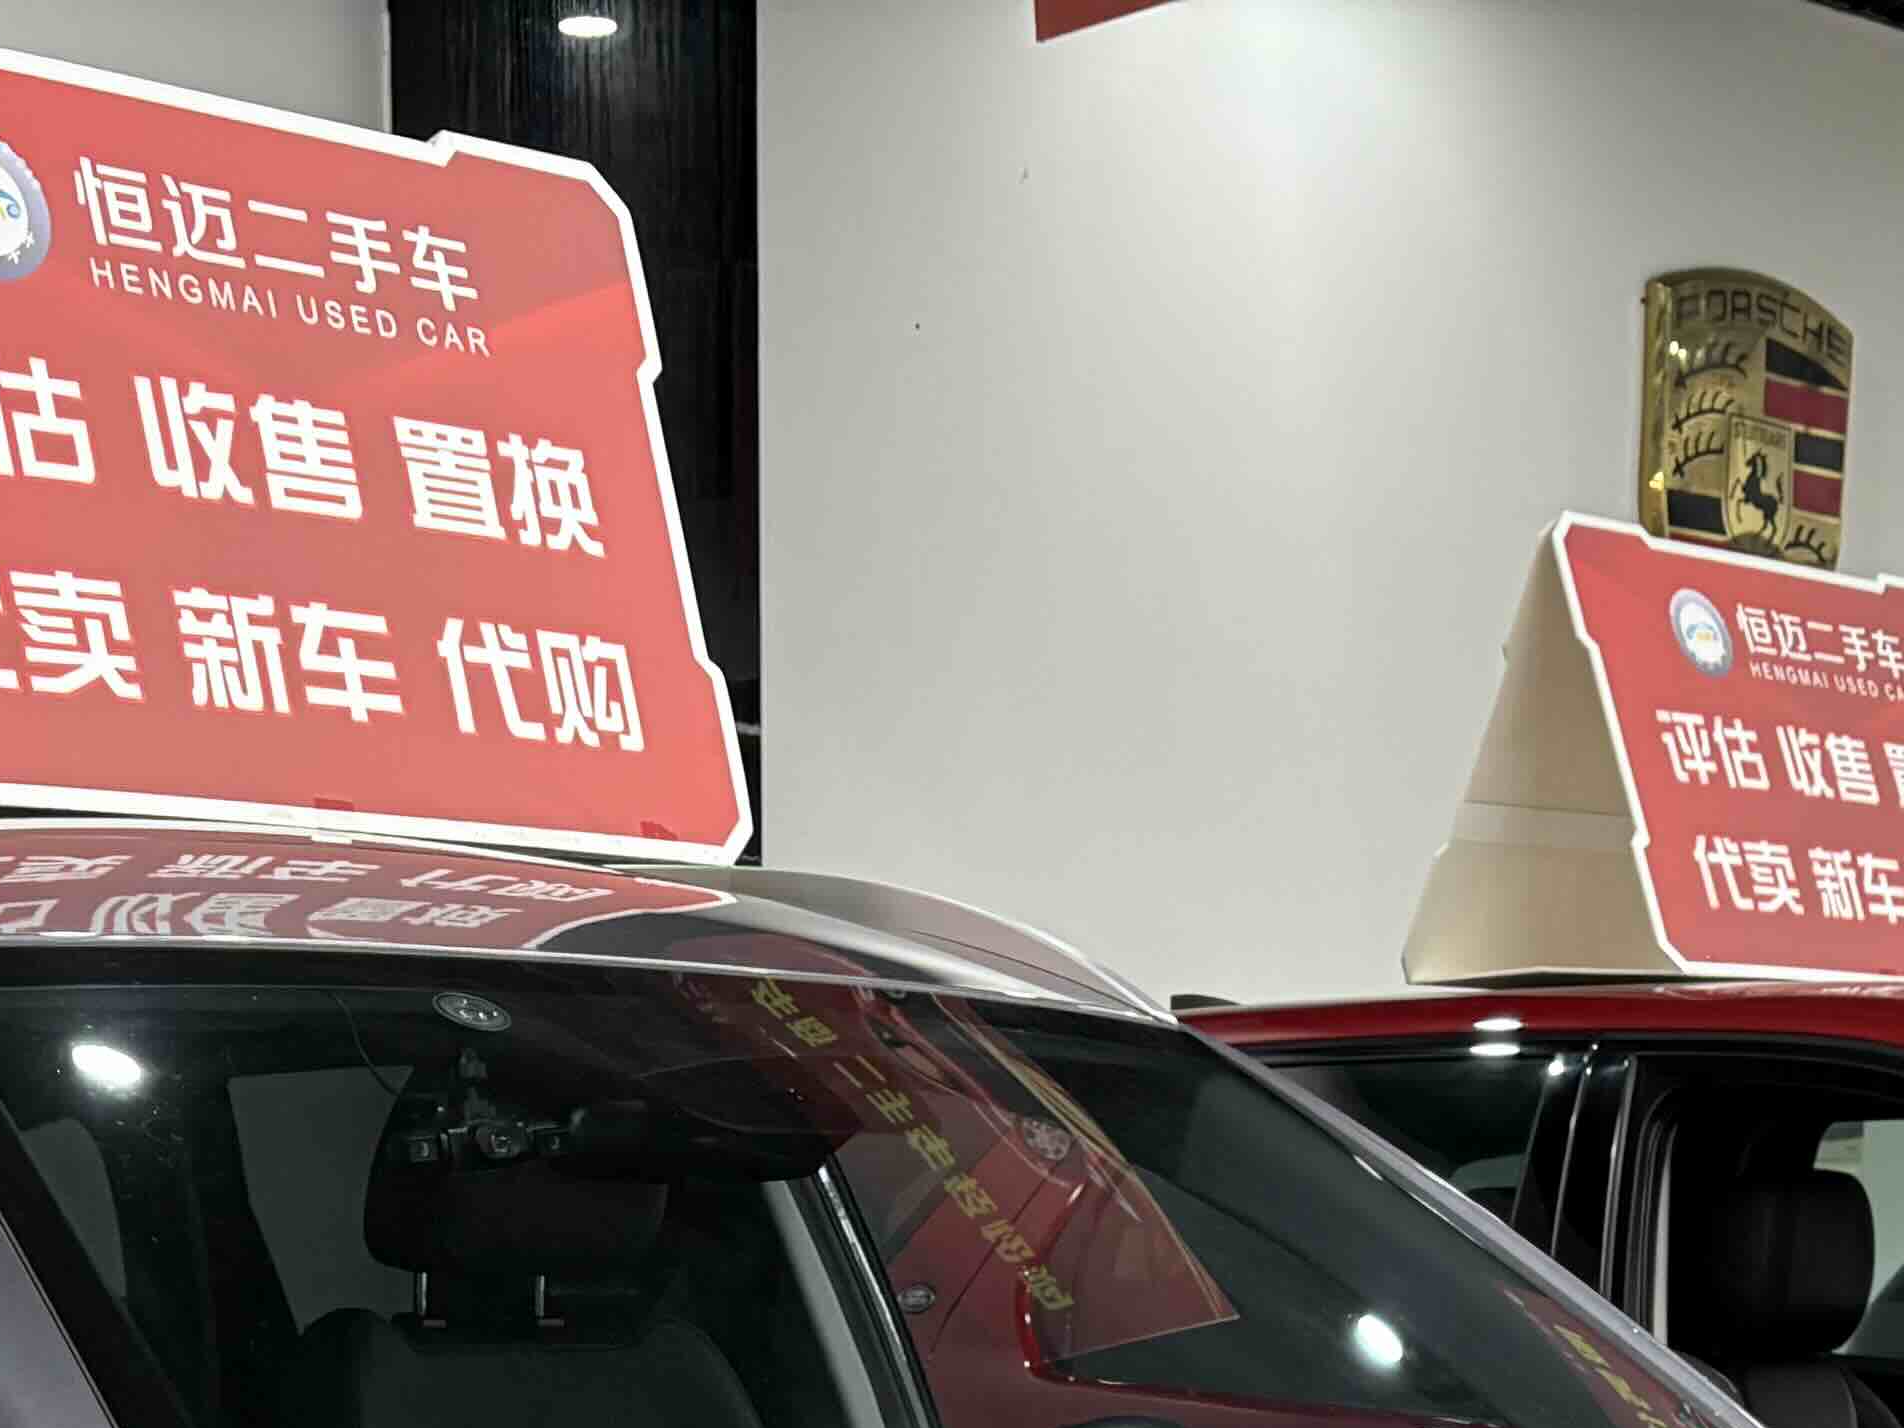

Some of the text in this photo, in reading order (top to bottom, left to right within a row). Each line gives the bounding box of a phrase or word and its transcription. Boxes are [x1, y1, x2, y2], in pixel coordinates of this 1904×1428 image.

[73, 155, 479, 311] 恒迈二手车
[88, 258, 491, 357] HENGMAI USED CAR
[1675, 288, 1847, 368] PORSCHE
[133, 373, 364, 523] 收售
[393, 413, 606, 559] 置换
[173, 585, 404, 724] 新车
[435, 616, 646, 754] 代购
[1749, 660, 1829, 689] HENGMAI
[1834, 674, 1879, 698] USED
[1655, 708, 1770, 791] 评估
[1775, 725, 1881, 806] 收售
[1693, 835, 1805, 918] 代卖
